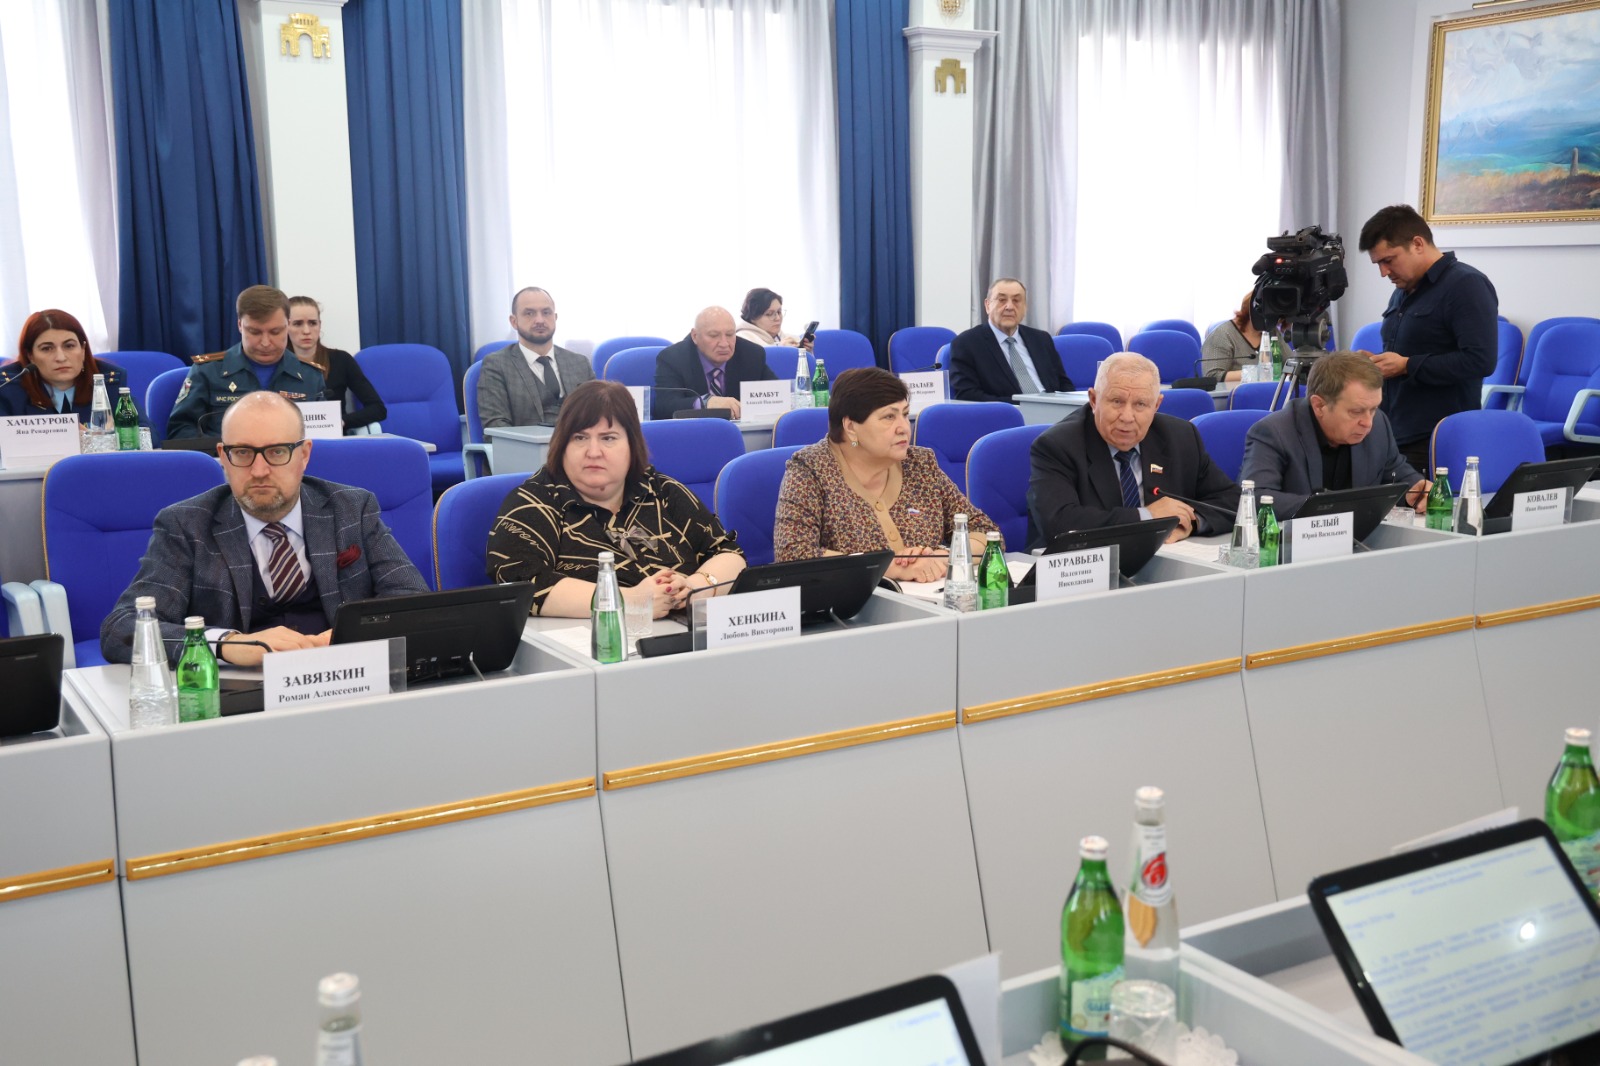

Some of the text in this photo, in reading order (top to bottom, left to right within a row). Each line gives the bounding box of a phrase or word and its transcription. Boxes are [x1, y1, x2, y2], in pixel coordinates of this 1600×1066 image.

[6, 416, 76, 427] ХАЧАТУРОВА
[303, 413, 327, 422] ДНИК
[1526, 492, 1558, 503] КОВАЛЕВ
[1310, 515, 1340, 529] БЕЛЫЙ
[1301, 530, 1348, 540] Юрий Васильевич
[1048, 553, 1104, 569] МУРАВЬЕВА
[1060, 569, 1092, 578] Валентина
[1058, 578, 1094, 588] Николаевна
[728, 611, 787, 627] ХЕНКИНА
[720, 625, 794, 641] Любовь Викторовна
[282, 666, 366, 688] ЗАВЯЗКИН
[278, 685, 371, 703] Роман Алексеевич
